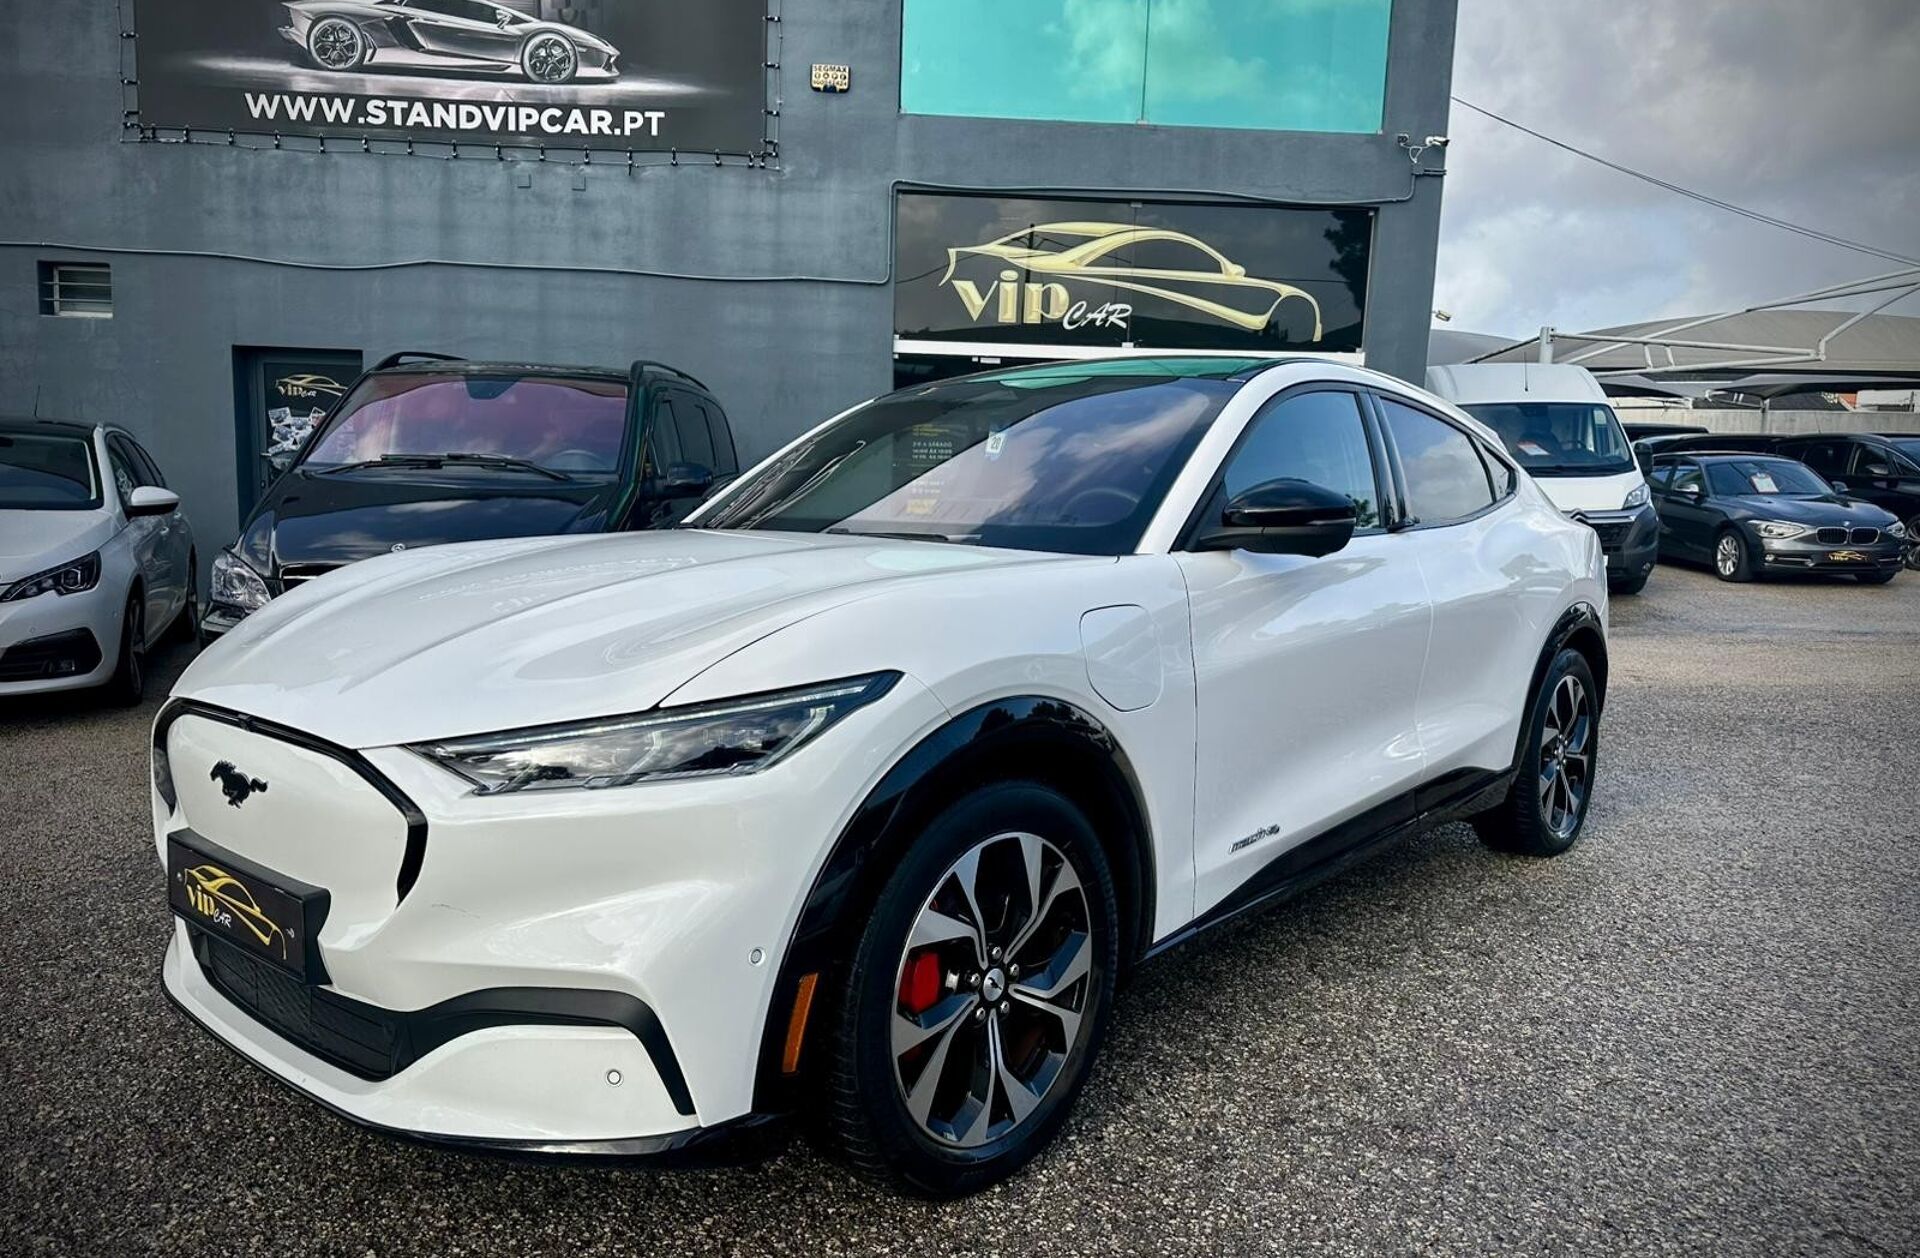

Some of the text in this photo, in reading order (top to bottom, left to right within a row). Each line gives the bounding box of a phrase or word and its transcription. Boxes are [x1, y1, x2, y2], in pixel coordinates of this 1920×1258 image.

[813, 65, 847, 73] SEGMAX
[244, 93, 666, 136] WWW.STANDVIPCAR.PT
[1062, 300, 1133, 331] CAR
